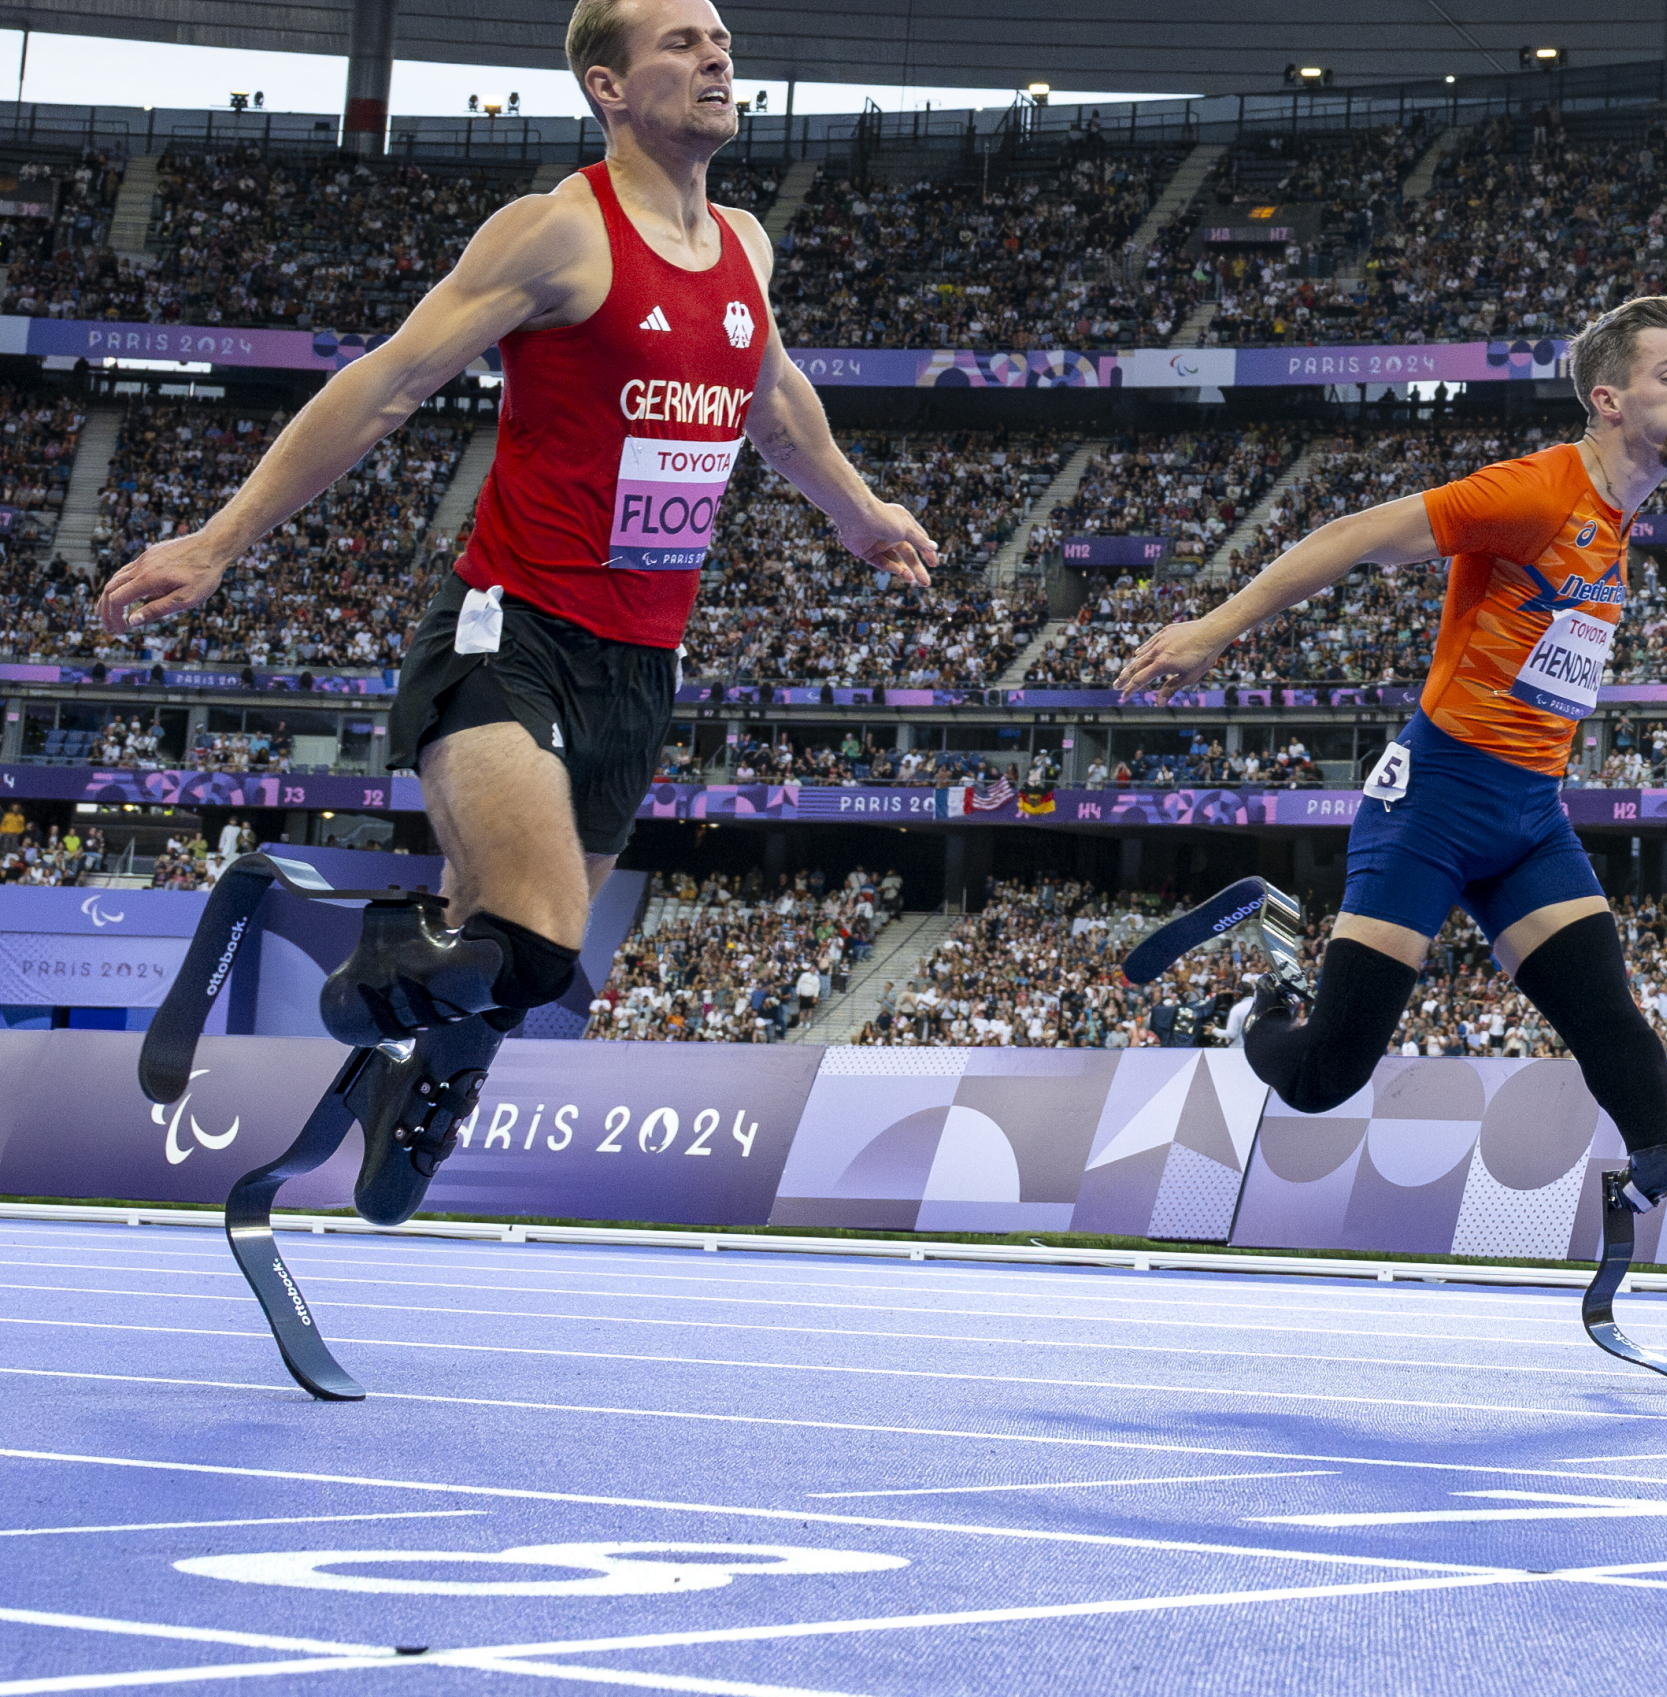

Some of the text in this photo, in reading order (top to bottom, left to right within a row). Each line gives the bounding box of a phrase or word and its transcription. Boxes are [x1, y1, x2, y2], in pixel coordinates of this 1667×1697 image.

[88, 330, 254, 355] PARIS 2024
[1289, 355, 1436, 376] PARIS 2024
[619, 378, 754, 429] GERMANY
[657, 451, 731, 473] TOYOTA
[619, 493, 722, 536] FLOO
[662, 553, 694, 565] PARIS
[1569, 618, 1608, 645] TOYOTA
[1377, 755, 1405, 789] 5
[284, 786, 305, 803] J3
[363, 788, 384, 806] J2
[839, 794, 935, 813] PARIS 20
[1077, 802, 1102, 820] H4
[1613, 802, 1637, 820] H2
[22, 960, 165, 980] PARIS 2024
[597, 1105, 759, 1158] 2024
[171, 1541, 912, 1597] 8
